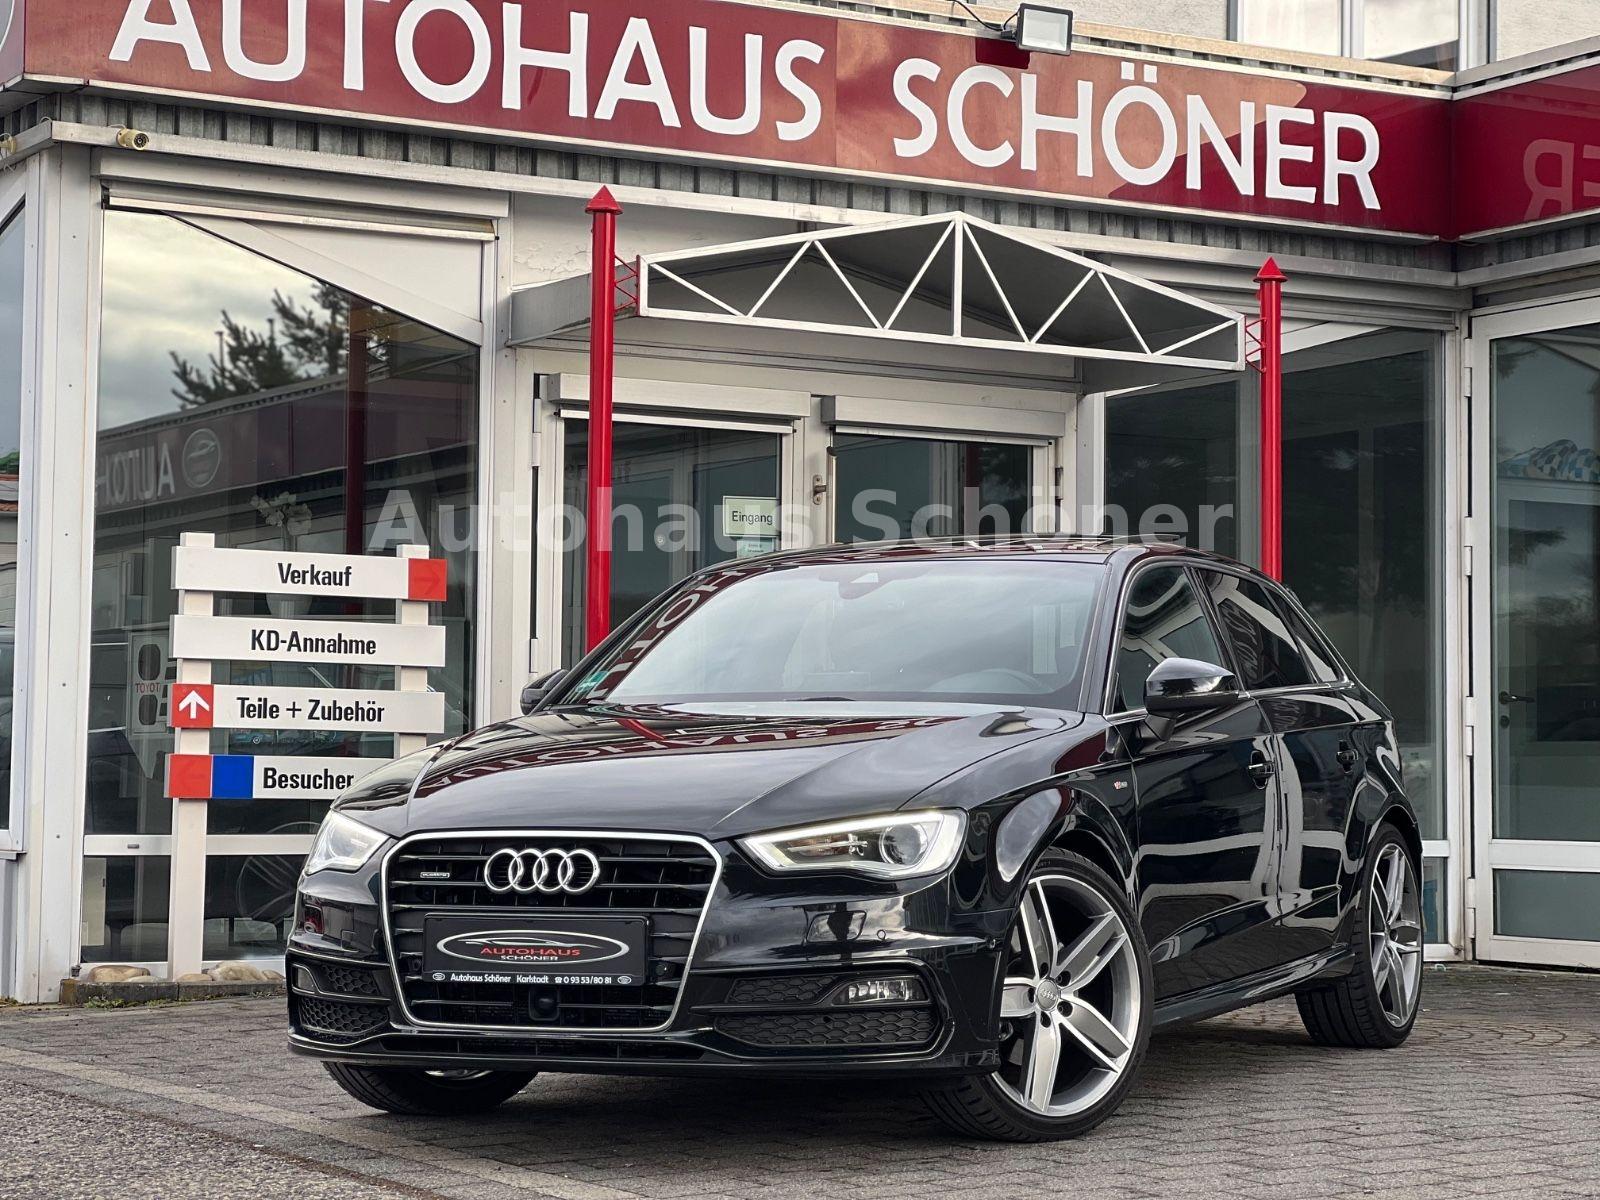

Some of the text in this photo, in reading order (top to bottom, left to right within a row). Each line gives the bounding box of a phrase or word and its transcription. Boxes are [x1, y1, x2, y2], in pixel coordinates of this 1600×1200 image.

[109, 0, 1381, 210] AUTOHAUS SCHÖNER
[732, 510, 773, 526] Eingang
[278, 563, 353, 588] Verkauf
[250, 629, 377, 656] KD-Annahme
[237, 697, 385, 723] Teile + Zubehör
[263, 768, 354, 790] Besucher
[480, 947, 581, 957] AUTOHAUS
[450, 973, 483, 983] Autohaus
[484, 974, 511, 984] Schöner
[516, 975, 549, 984] Karlstadt
[570, 976, 580, 984] 93
[580, 975, 603, 985] 53/80
[604, 976, 612, 984] 81
